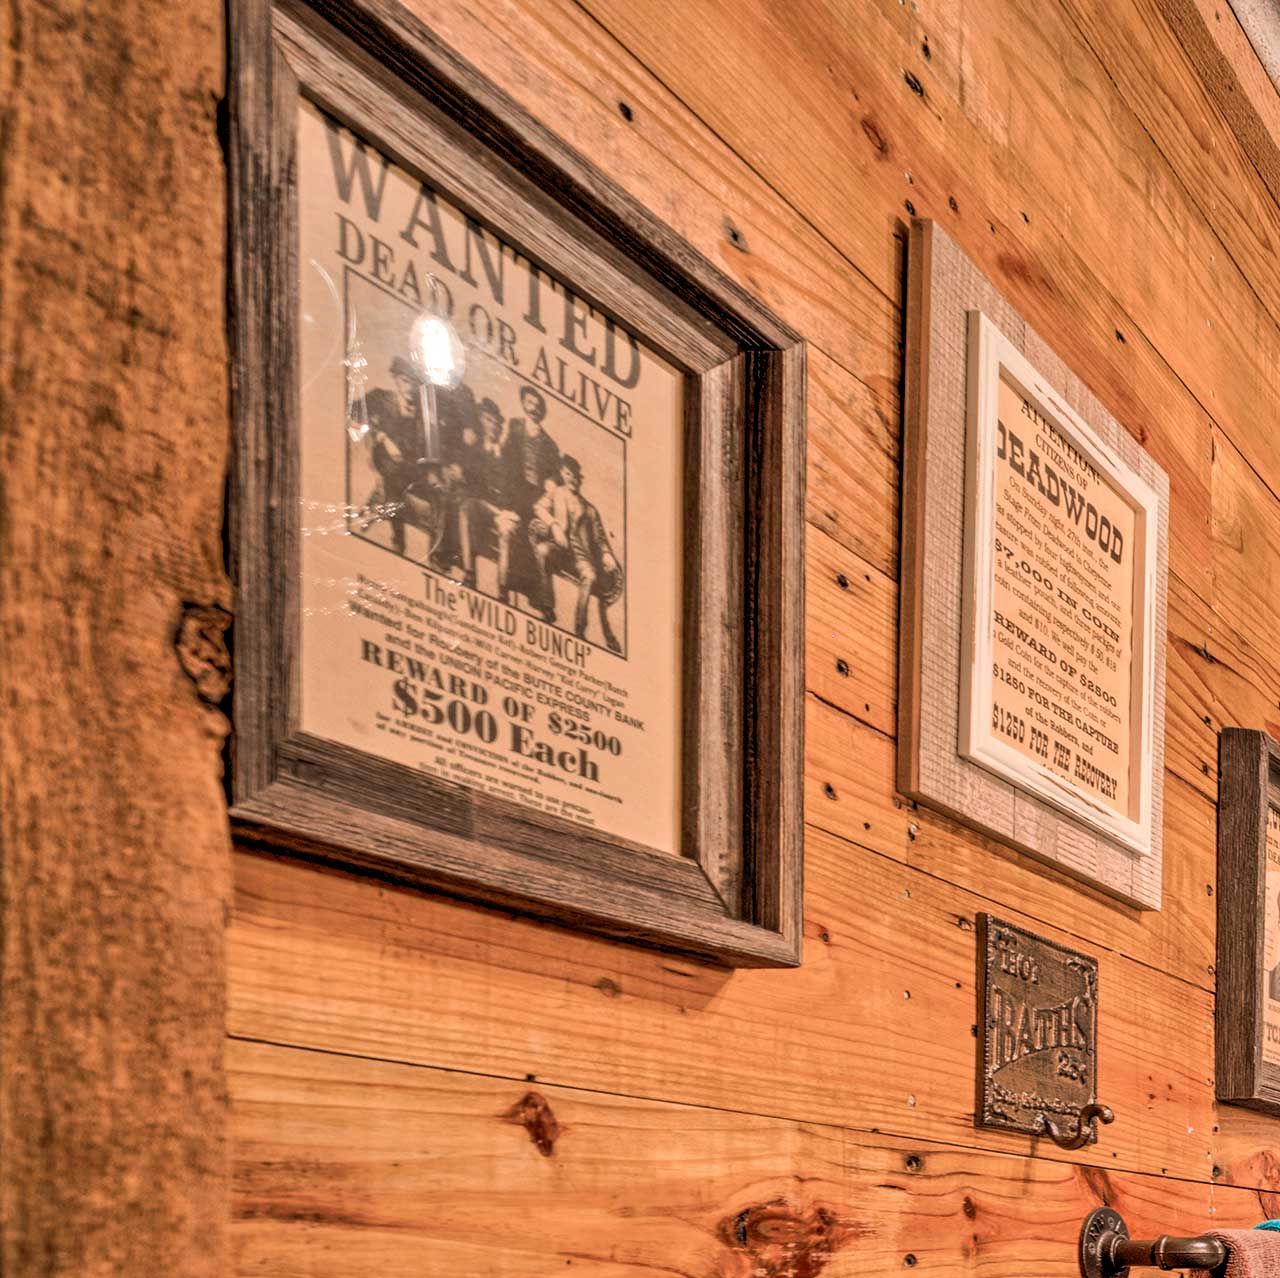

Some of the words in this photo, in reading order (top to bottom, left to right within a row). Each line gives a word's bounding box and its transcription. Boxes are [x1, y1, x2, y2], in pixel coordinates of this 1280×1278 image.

[321, 112, 641, 398] WANTED
[335, 211, 453, 327] DEAD
[468, 298, 519, 368] OR
[531, 340, 631, 439] ALIVE
[1009, 475, 1020, 492] On
[1022, 487, 1046, 518] Sunday
[1035, 432, 1073, 479] CITIZENS
[1076, 471, 1087, 491] OF
[1003, 487, 1022, 516] Stage
[1024, 506, 1040, 530] From
[1042, 523, 1074, 559] Deadwood
[1083, 559, 1111, 593] Cheyenne
[1034, 534, 1041, 550] by
[422, 572, 456, 611] The
[995, 538, 1053, 595] $7,000
[1056, 587, 1077, 610] IN
[1082, 605, 1119, 643] COIN
[350, 602, 401, 630] Wanted
[406, 625, 424, 640] for
[485, 658, 499, 670] of
[500, 664, 519, 679] the
[523, 673, 561, 697] BUTTE
[565, 690, 611, 717] COUNTY
[614, 711, 644, 731] BANK
[384, 631, 409, 649] and
[415, 643, 434, 659] the
[439, 653, 480, 677] UNION
[484, 671, 532, 698] PACIFIC
[536, 692, 589, 721] EXPRESS
[993, 609, 1056, 664] REWARD
[1059, 658, 1076, 679] OF
[1079, 672, 1116, 708] $2500
[997, 630, 1013, 650] Gold
[1015, 644, 1031, 663] Coin
[1033, 656, 1042, 670] for
[1007, 655, 1021, 672] and
[1023, 666, 1034, 681] the
[360, 636, 487, 708] REWARD
[503, 694, 536, 726] OF
[547, 710, 621, 758] $2500
[391, 671, 497, 749] $500
[509, 720, 599, 783] Each
[992, 662, 1025, 695] $1250
[1027, 686, 1049, 710] FOR
[1051, 701, 1073, 725] THE
[1075, 716, 1118, 754] CAPTURE
[1025, 703, 1033, 717] of
[1035, 710, 1048, 726] the
[1081, 739, 1093, 755] and
[992, 701, 1024, 745] $1250
[1029, 725, 1048, 758] FOR
[1053, 740, 1070, 771] THE
[1074, 754, 1117, 800] RECOVERY
[990, 984, 1091, 1073] BATHS
